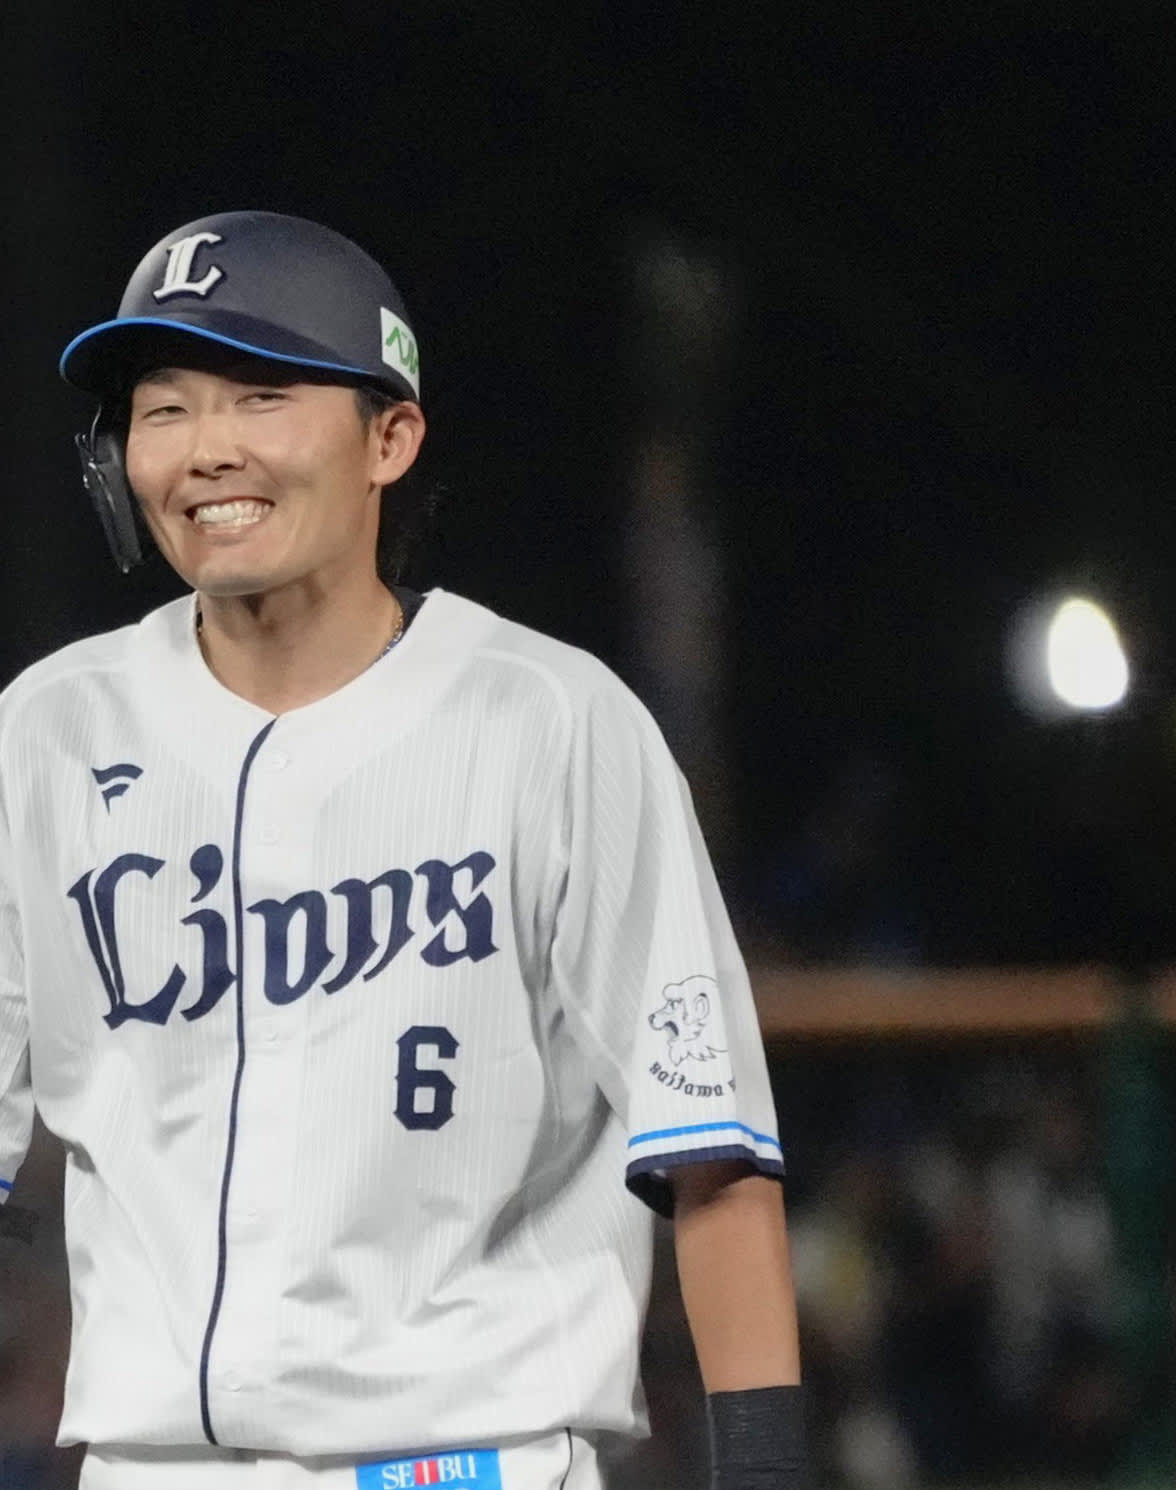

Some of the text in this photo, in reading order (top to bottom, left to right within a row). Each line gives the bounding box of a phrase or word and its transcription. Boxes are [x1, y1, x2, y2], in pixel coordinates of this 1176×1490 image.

[153, 232, 226, 304] L
[67, 844, 500, 1030] Lions
[393, 1025, 460, 1131] 6
[382, 1453, 477, 1490] SEIBU
